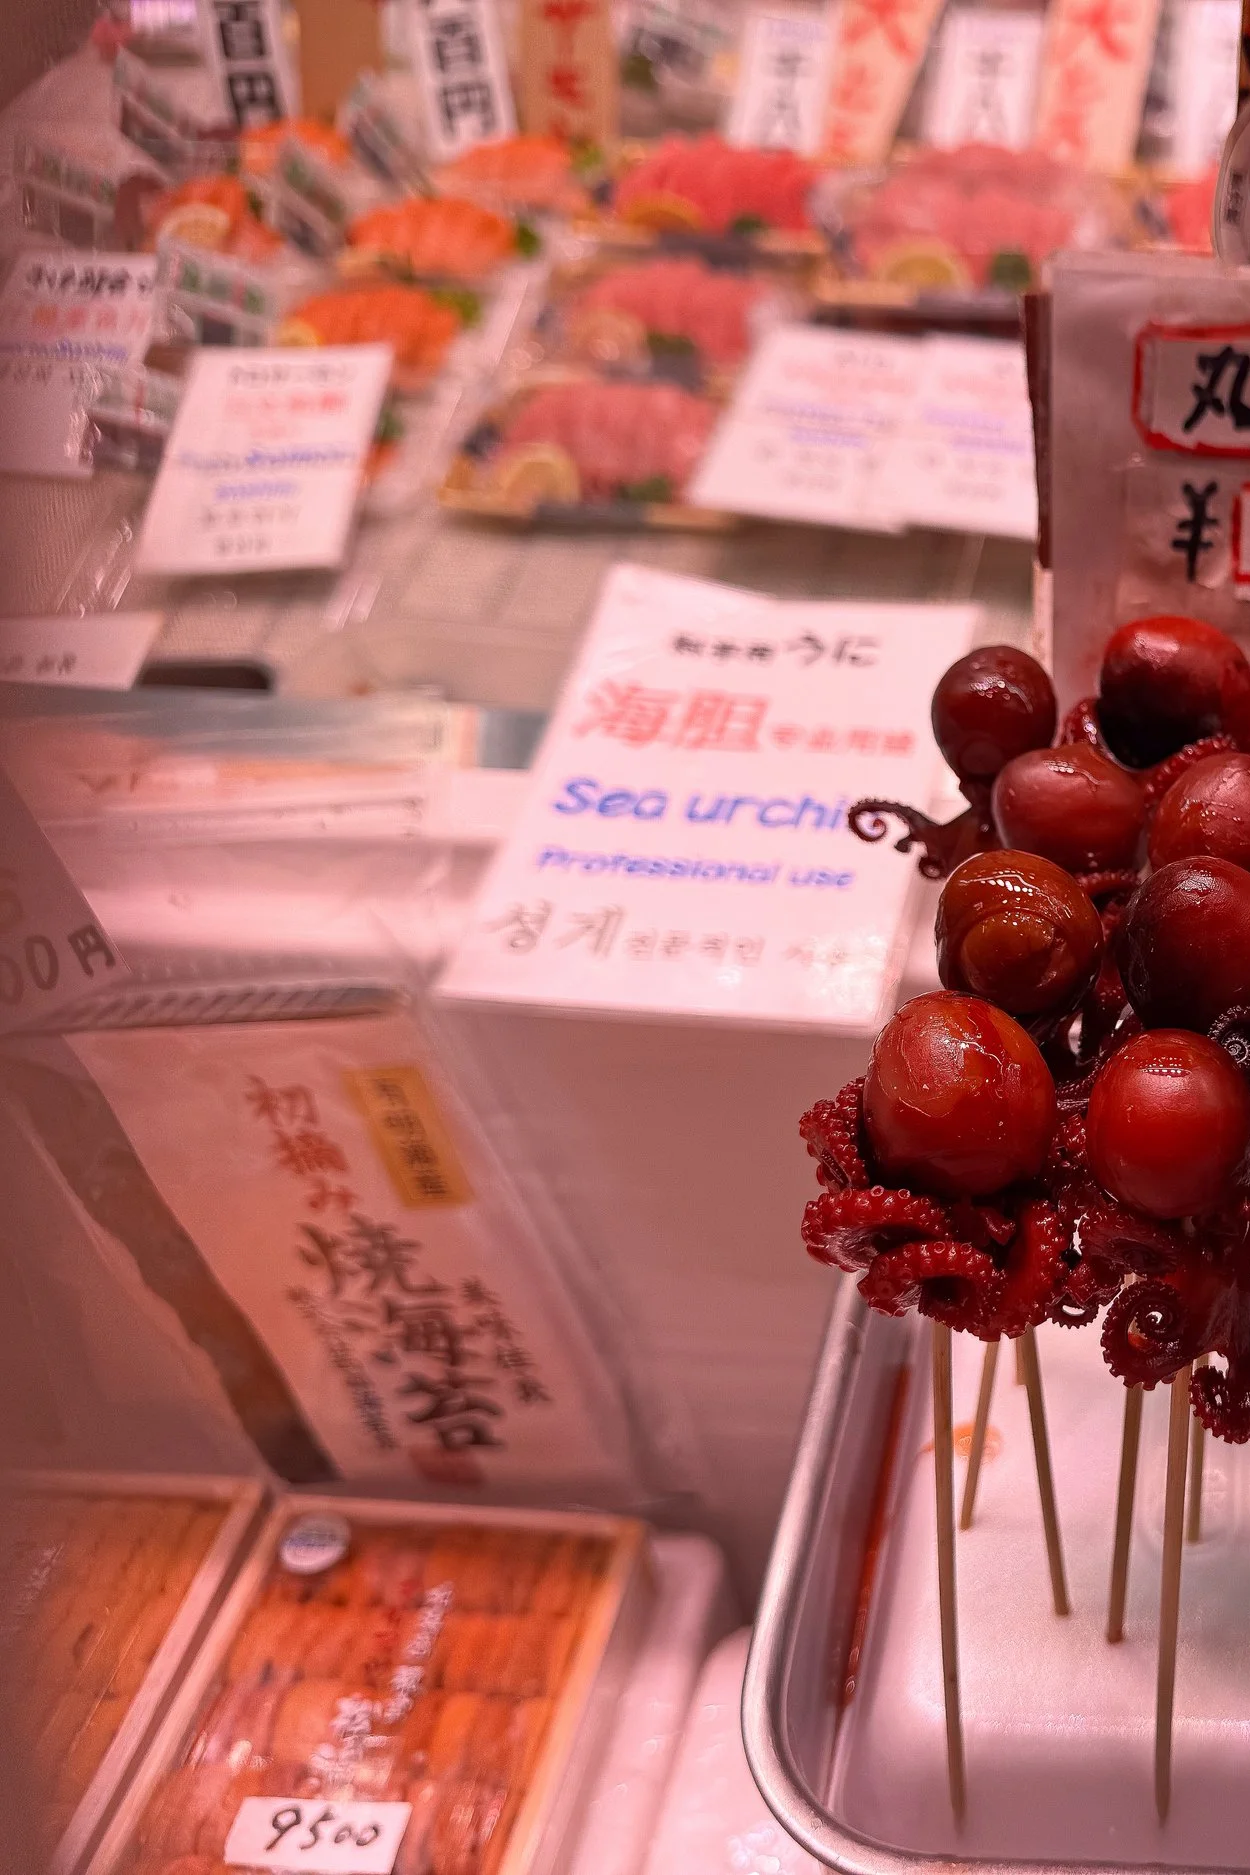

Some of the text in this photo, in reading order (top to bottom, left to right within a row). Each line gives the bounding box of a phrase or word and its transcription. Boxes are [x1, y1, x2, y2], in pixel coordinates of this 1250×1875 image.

[553, 777, 668, 820] Sea
[537, 845, 856, 890] Professional use
[295, 1213, 508, 1450] 焼海苔
[264, 1804, 382, 1853] 9500
